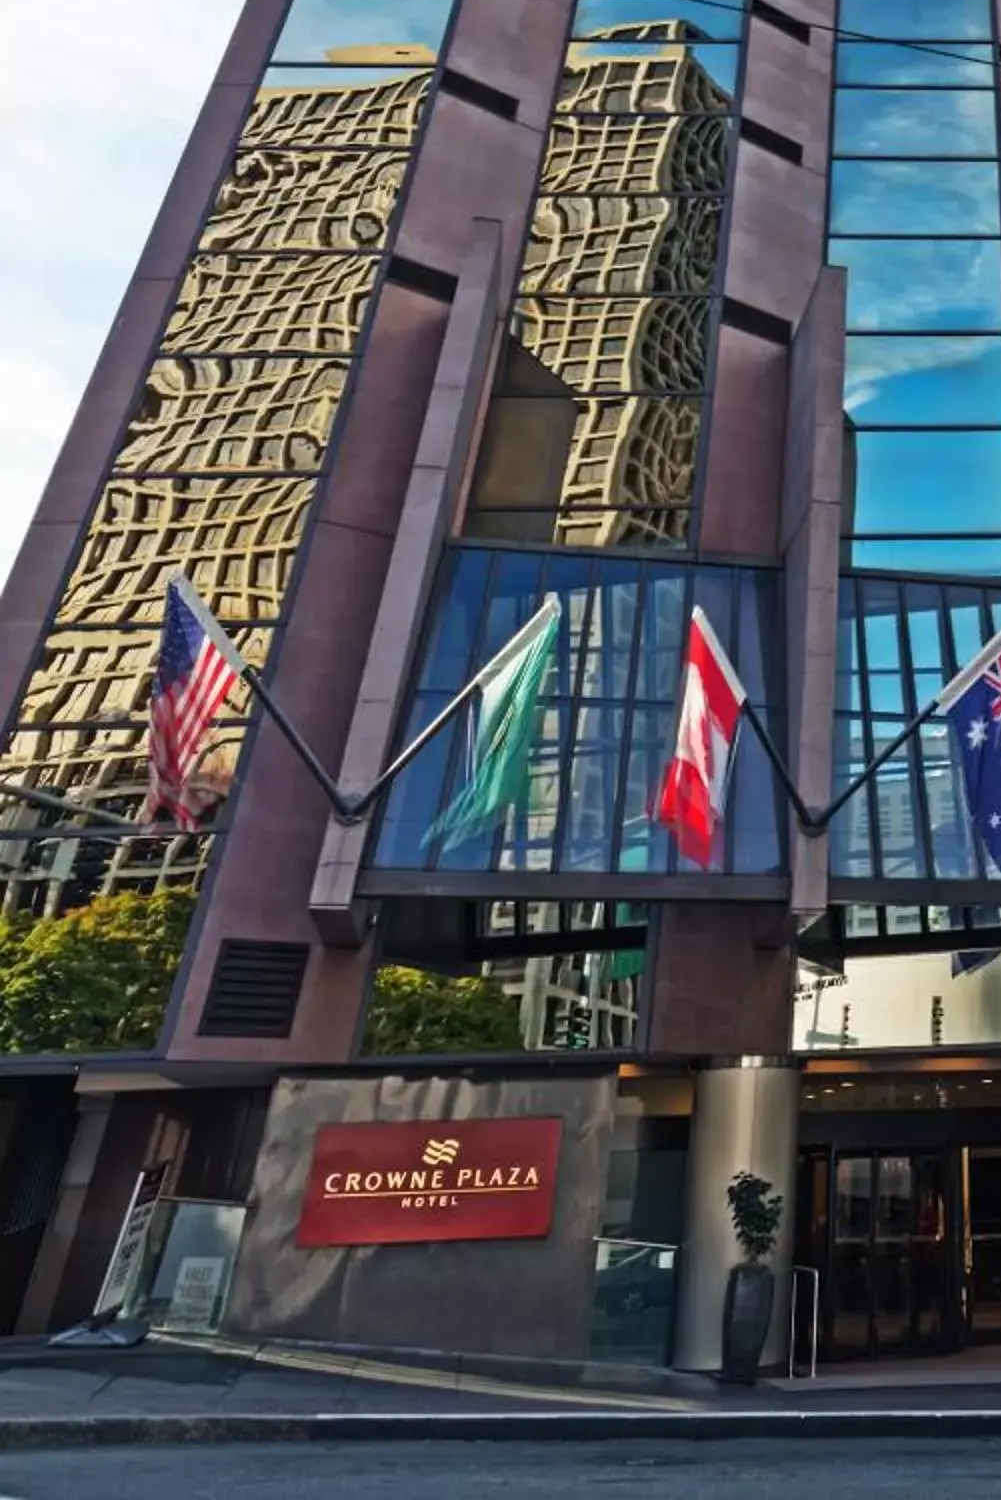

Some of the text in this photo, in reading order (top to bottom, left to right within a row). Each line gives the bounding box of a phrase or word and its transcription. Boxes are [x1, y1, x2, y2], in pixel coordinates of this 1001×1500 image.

[325, 1167, 538, 1192] CROWNE PLAZA
[401, 1196, 459, 1208] HOTEL
